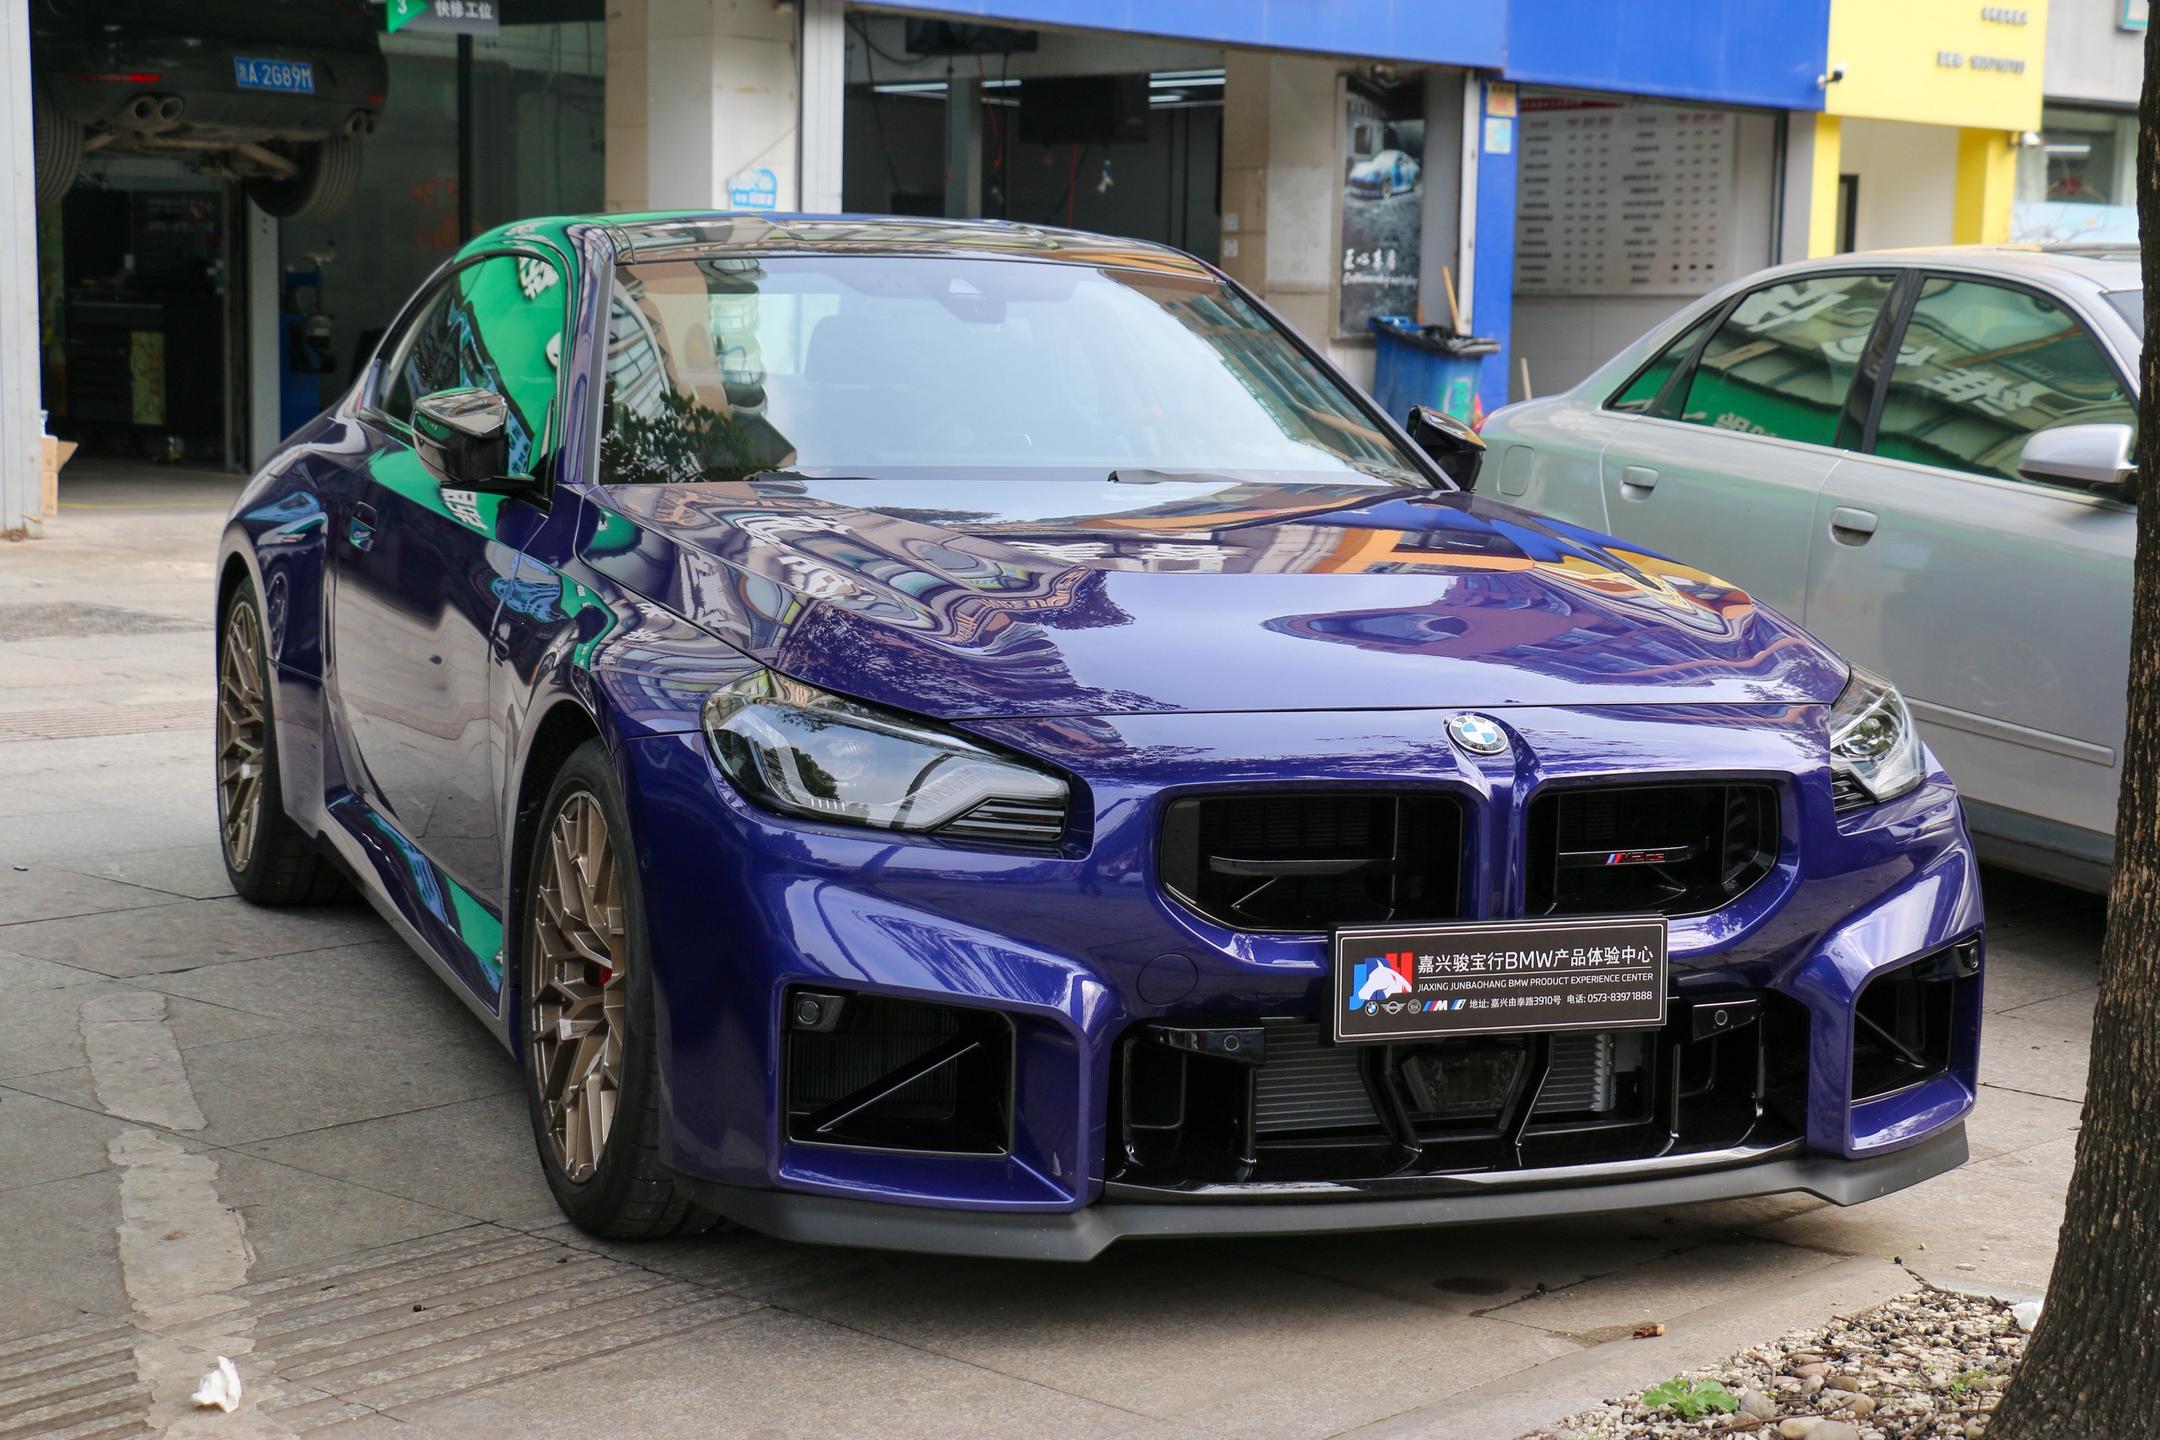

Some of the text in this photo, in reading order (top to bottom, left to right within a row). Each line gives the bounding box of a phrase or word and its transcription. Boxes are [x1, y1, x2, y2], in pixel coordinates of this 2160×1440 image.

[1418, 945, 1654, 974] 嘉兴骏宝行BMW产品体验中心
[1417, 972, 1654, 993] JIAXING JUNBAOHANG BMW PRODUCT EXPERIENCE CENTER
[1587, 991, 1653, 1003] 0573-83971888
